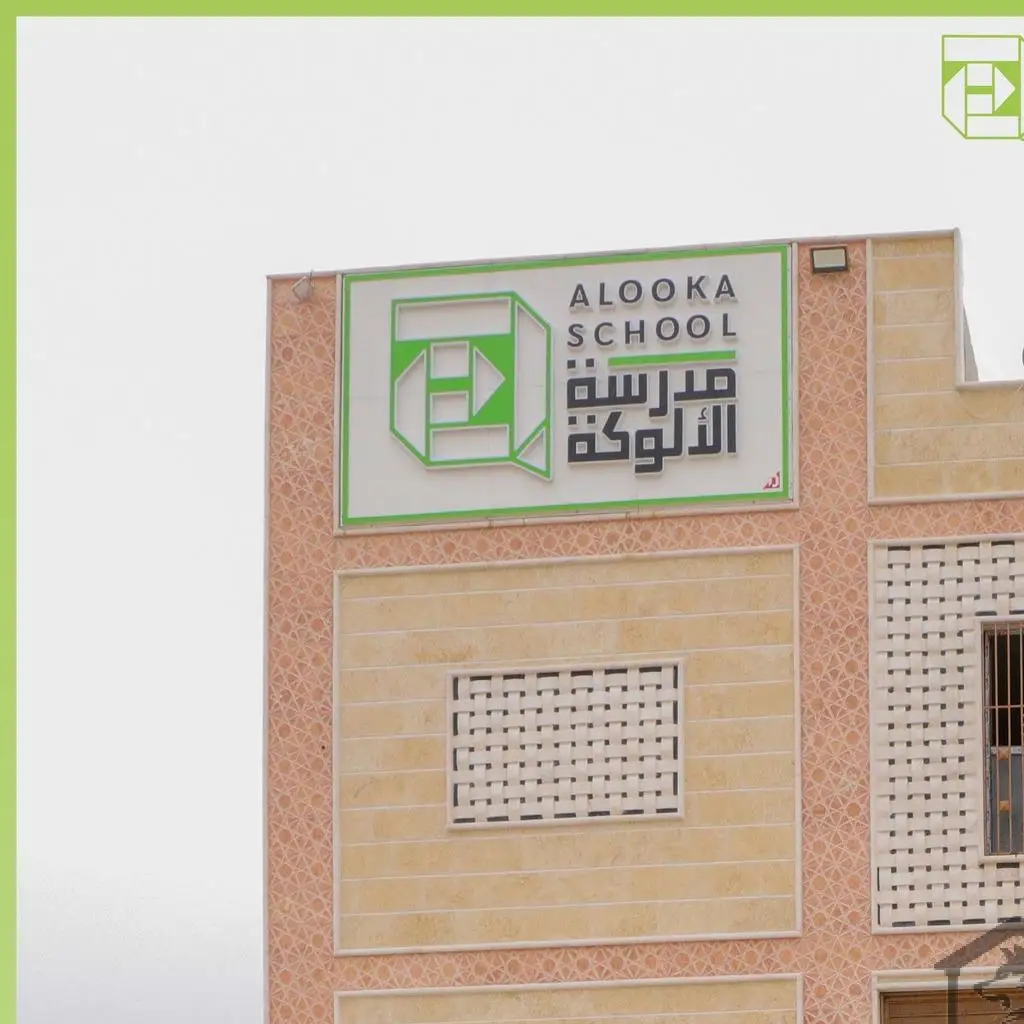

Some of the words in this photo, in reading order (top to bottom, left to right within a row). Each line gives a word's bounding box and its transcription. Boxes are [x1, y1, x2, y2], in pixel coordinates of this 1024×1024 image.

[569, 274, 736, 308] ALOOKA
[567, 313, 737, 348] SCHOOL
[567, 358, 736, 418] مدرسة
[567, 404, 737, 474] الألوكة
